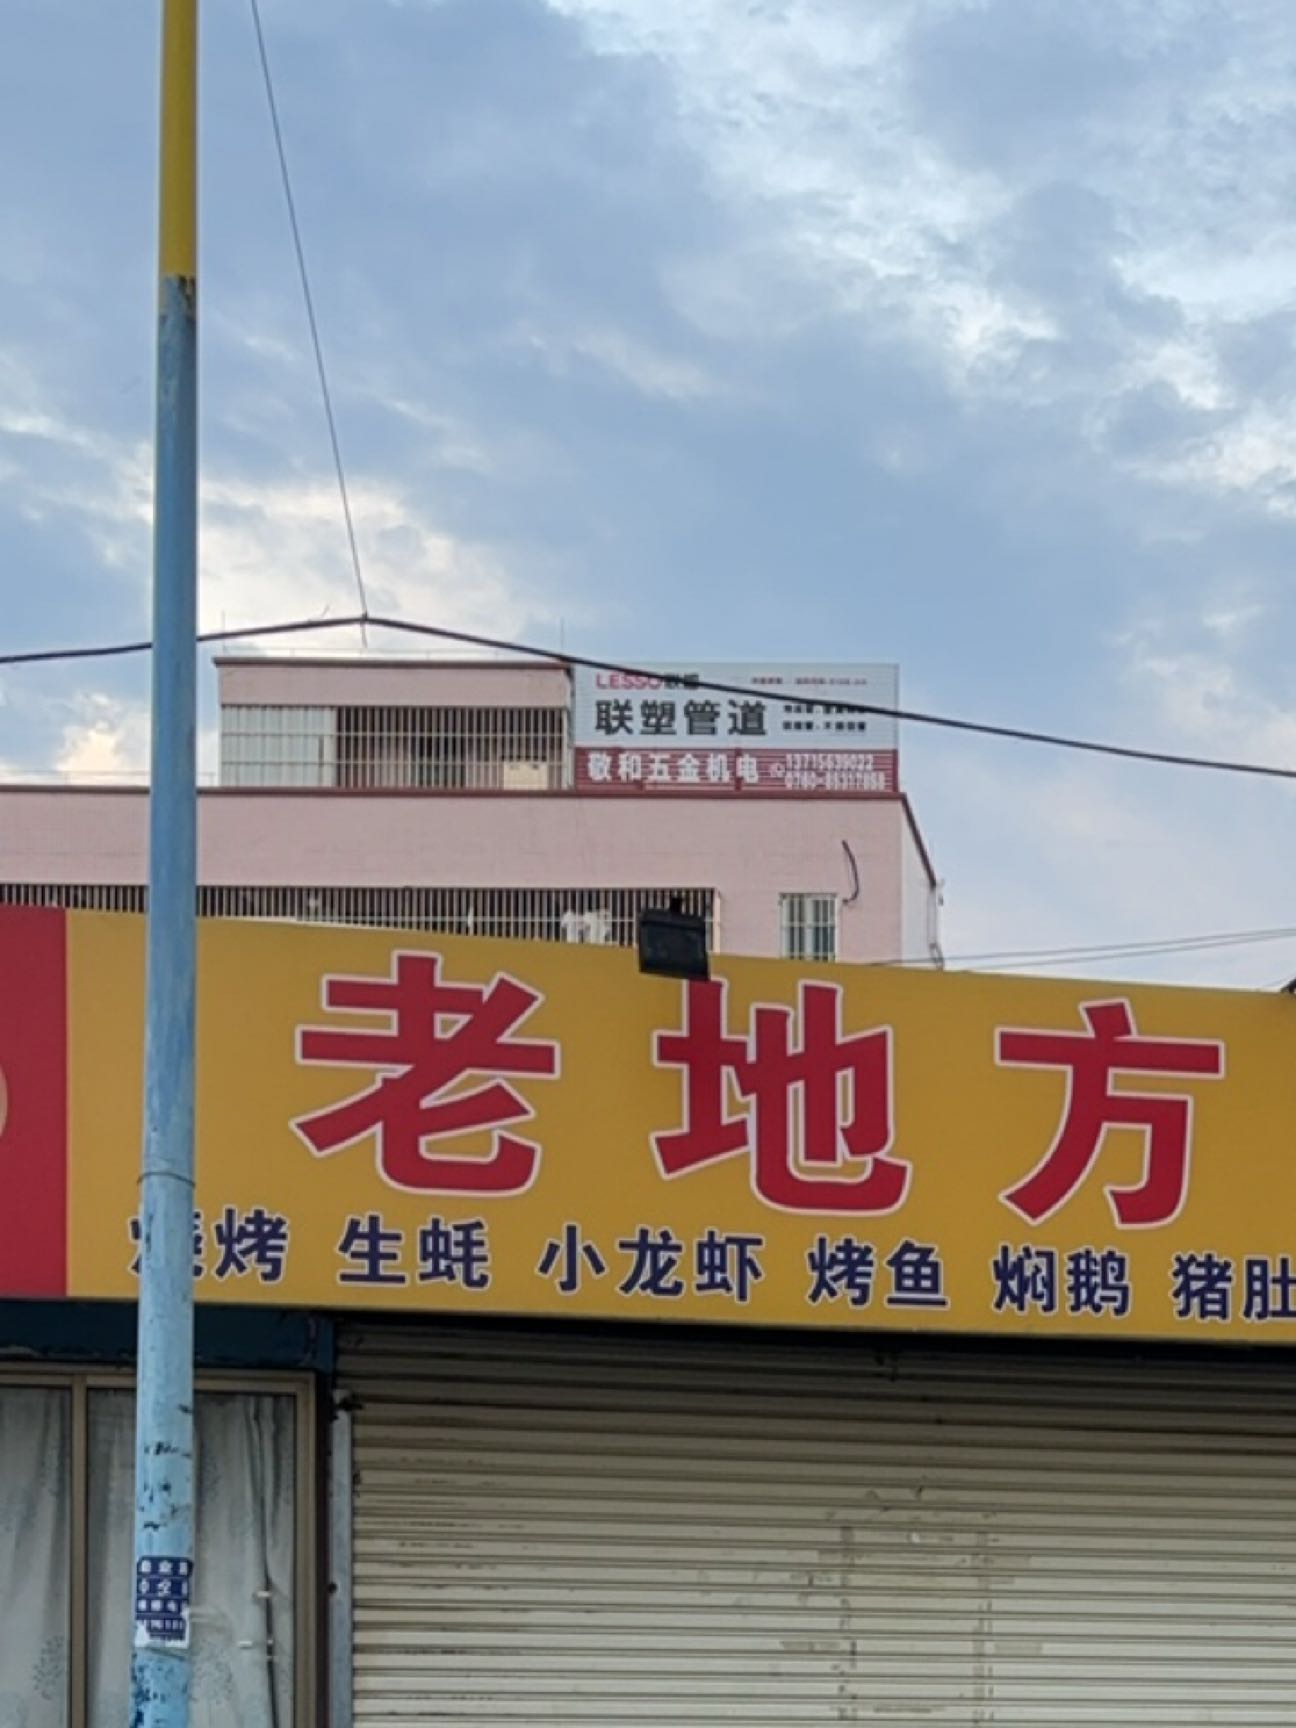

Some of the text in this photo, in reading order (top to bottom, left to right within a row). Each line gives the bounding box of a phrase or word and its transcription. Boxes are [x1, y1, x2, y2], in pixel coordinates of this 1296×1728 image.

[595, 698, 767, 736] 联塑管道
[130, 1206, 289, 1284] 烤
[337, 1215, 490, 1290] 生蚝
[538, 1223, 764, 1302] 小龙虾
[806, 1236, 948, 1308] 烤鱼
[992, 1244, 1131, 1317] 焖鹅
